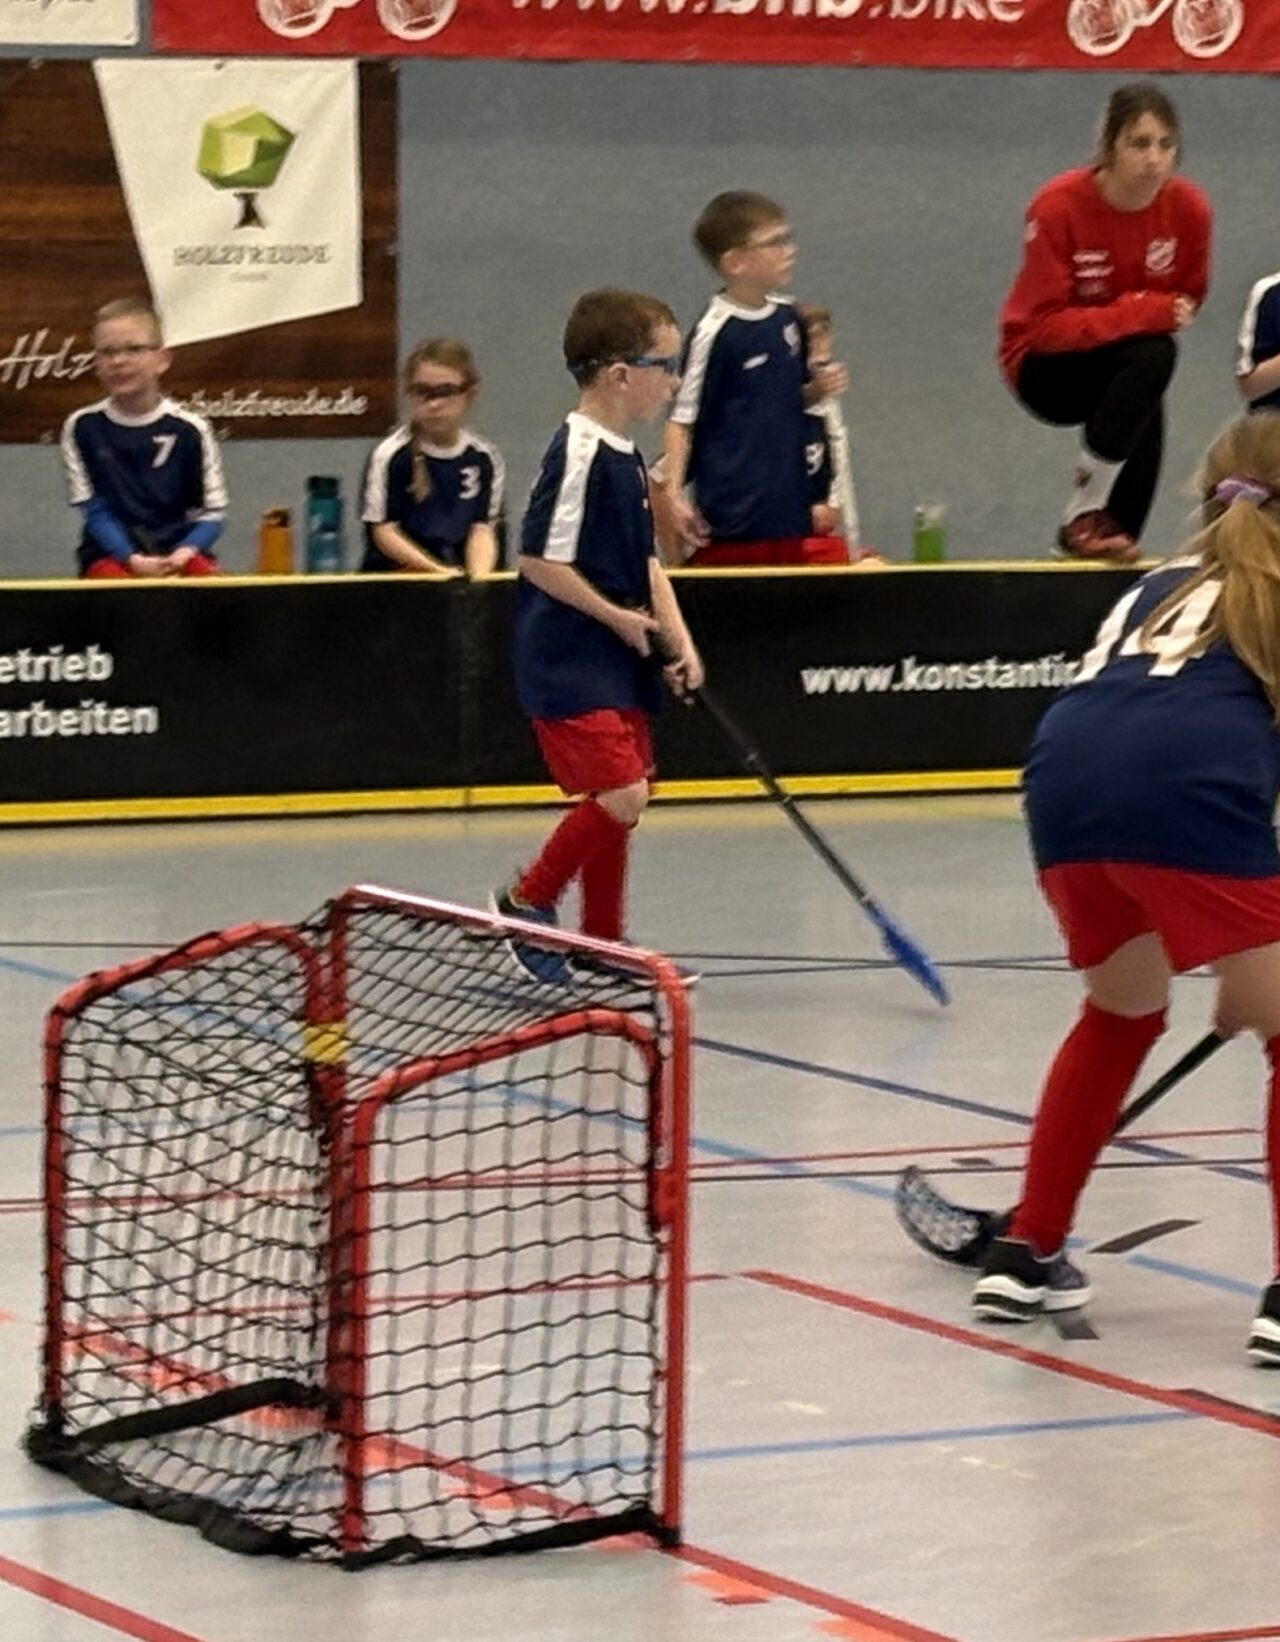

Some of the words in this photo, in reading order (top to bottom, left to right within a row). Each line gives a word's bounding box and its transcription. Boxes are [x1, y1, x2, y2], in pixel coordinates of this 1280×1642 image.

[151, 432, 178, 469] 7
[458, 465, 481, 500] 3
[1072, 580, 1224, 678] 14
